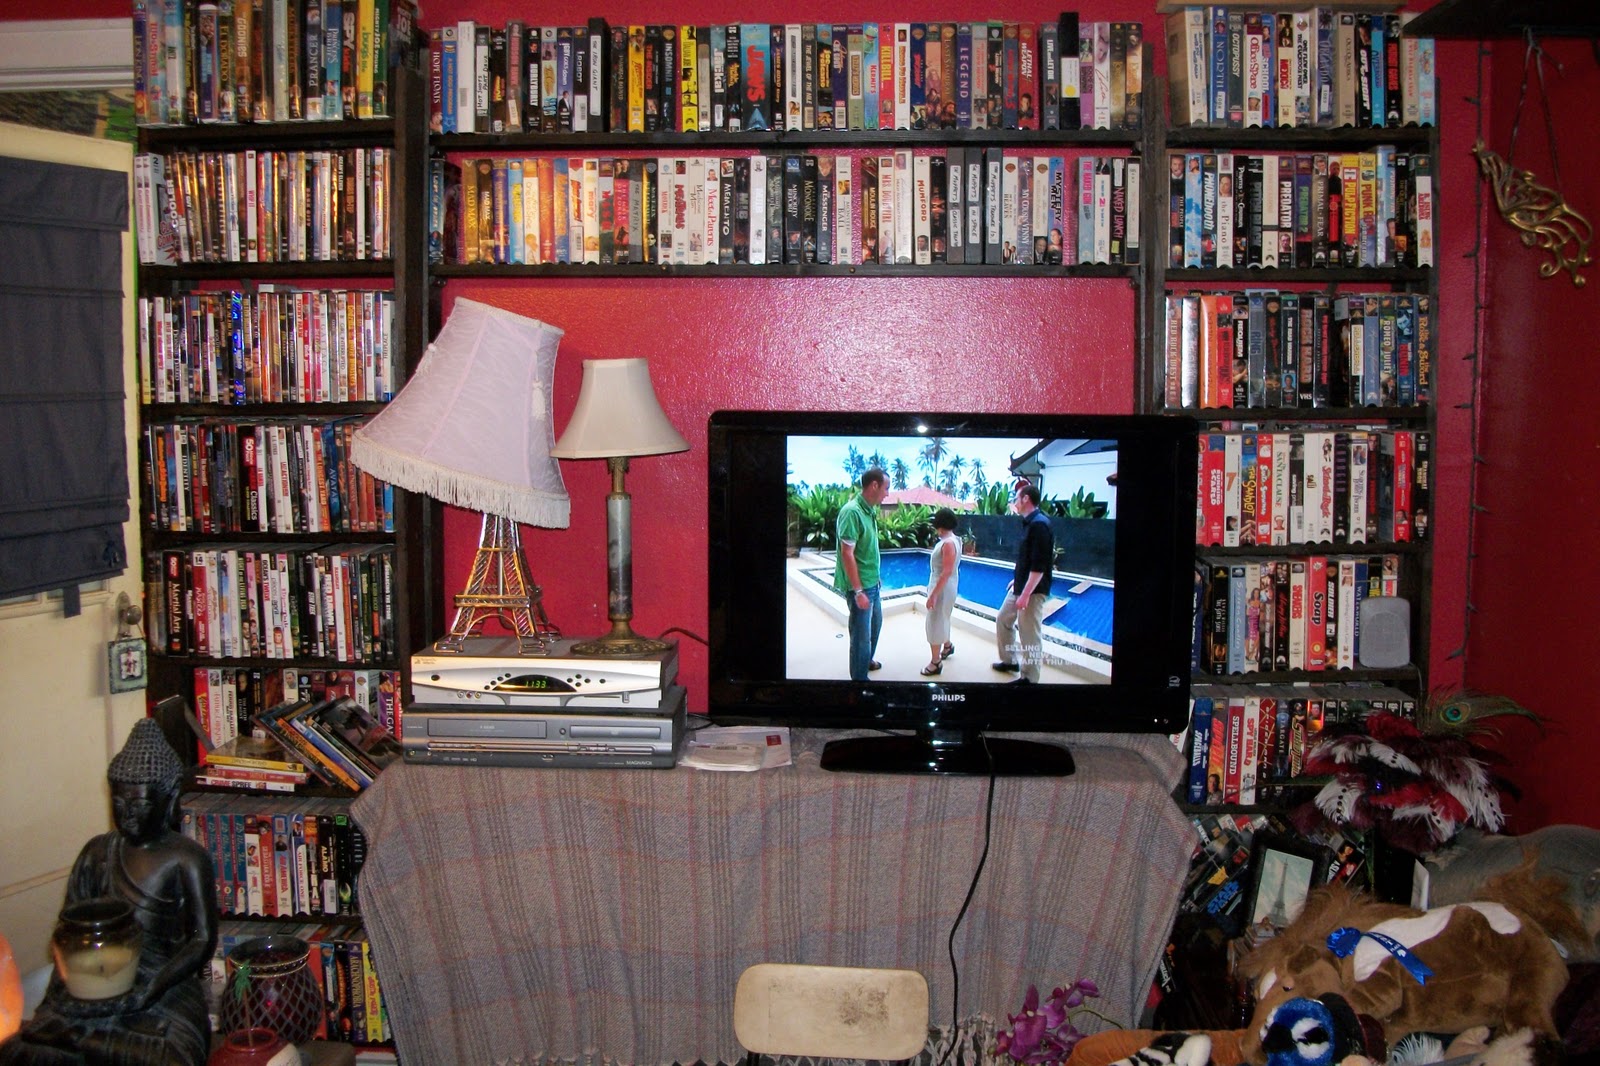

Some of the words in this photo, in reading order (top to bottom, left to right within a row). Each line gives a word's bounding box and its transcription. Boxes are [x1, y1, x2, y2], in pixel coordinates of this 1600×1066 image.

[343, 11, 355, 50] SPY
[308, 34, 319, 87] PRANCER
[433, 51, 441, 73] HOPE
[664, 43, 673, 82] INSOMNIA
[881, 46, 892, 63] KILL
[1232, 33, 1240, 78] OCTOPUSSY
[1250, 37, 1260, 62] Office
[746, 45, 765, 102] JAWS
[881, 63, 892, 81] BILL
[960, 47, 969, 98] LEGEND
[1216, 41, 1224, 88] NORTH
[433, 76, 442, 104] FLOATS
[1361, 76, 1370, 110] SIGHT
[1083, 161, 1092, 170] THE
[167, 179, 178, 227] COOLER
[467, 185, 477, 206] MAD
[483, 191, 491, 206] MAD
[804, 180, 814, 222] MONONOKE
[917, 180, 927, 222] MUMFORD
[1083, 192, 1092, 205] GUN
[1113, 187, 1124, 212] NAKED
[1280, 181, 1292, 228] PREDATOR
[1317, 181, 1325, 212] PRIMAL
[1344, 181, 1356, 202] PULP
[1361, 183, 1372, 208] PUNK
[467, 208, 477, 229] MAX
[483, 206, 491, 220] MAX
[723, 183, 732, 236] MEMENTO
[1021, 199, 1030, 222] COUSIN
[1299, 185, 1310, 226] PREDATOR
[1345, 202, 1357, 234] FICTION
[1022, 223, 1030, 245] VINNY
[1113, 214, 1124, 238] LUNCH
[1221, 215, 1230, 243] Piano
[1317, 216, 1325, 237] FEAR
[1169, 320, 1177, 336] RED
[1236, 320, 1244, 358] REQUIEM
[1383, 320, 1391, 346] ROMEO
[1169, 337, 1177, 357] ROCK
[1250, 331, 1263, 354] RING
[1353, 326, 1361, 374] ROLLERBALL
[1169, 359, 1177, 381] WEST
[1383, 351, 1391, 374] JULIET
[1399, 343, 1409, 376] RONIN
[245, 438, 254, 451] 50
[317, 462, 326, 489] LONGEST
[329, 468, 338, 504] AVATAR
[250, 490, 258, 520] Classics
[319, 490, 327, 505] YARD
[1242, 480, 1257, 516] SANDLOT
[1274, 478, 1282, 508] CLAUSE
[325, 574, 334, 594] RED
[172, 583, 182, 614] Martial
[272, 600, 280, 614] april
[307, 591, 315, 604] STAR
[308, 604, 316, 616] TREK
[326, 595, 335, 626] DAWN
[1291, 585, 1303, 619] SNEAKERS
[1311, 592, 1324, 625] Soap
[1327, 581, 1335, 619] SOLDIER
[174, 615, 182, 633] Arts
[1004, 644, 1041, 652] SELLING
[385, 697, 394, 715] THE
[931, 694, 966, 702] PHILIPS
[1246, 718, 1254, 738] SPY
[1192, 730, 1203, 766] SPACEBALLS
[1229, 715, 1240, 775] SPELLBOUND
[1243, 739, 1254, 766] HARD
[321, 846, 329, 872] ALAMO
[349, 956, 362, 1008] ARACHNOPHOBIA
